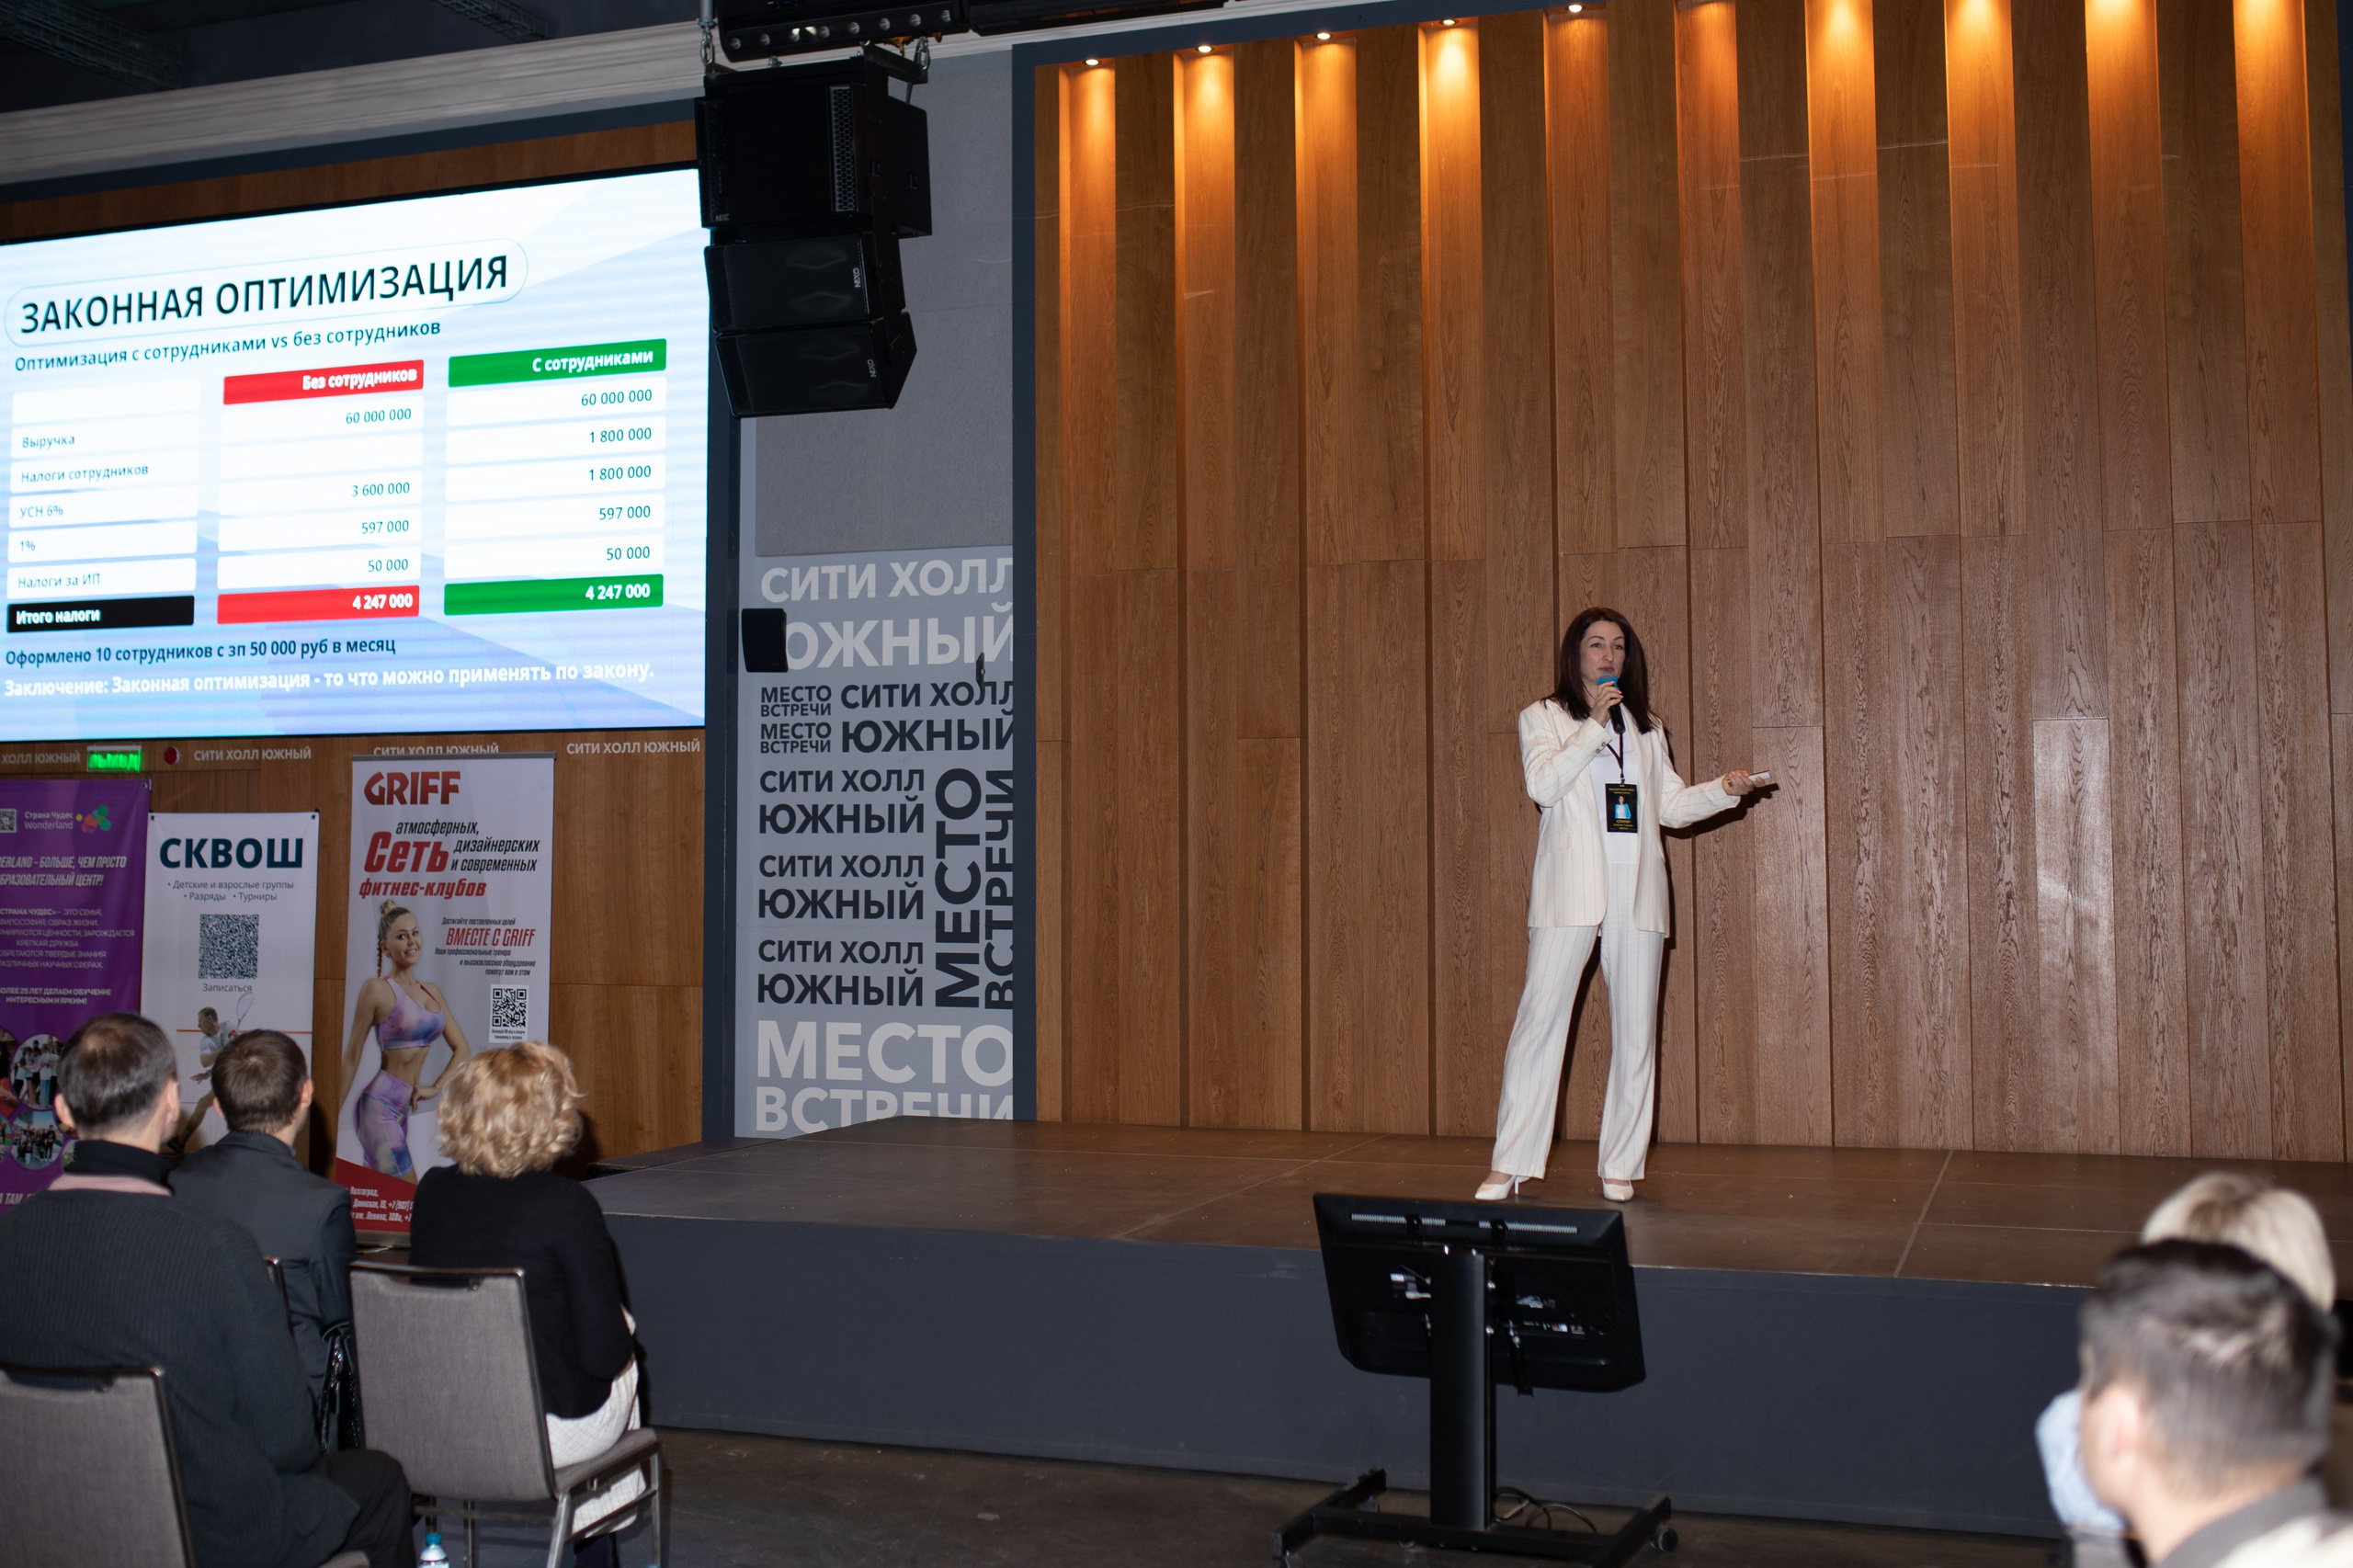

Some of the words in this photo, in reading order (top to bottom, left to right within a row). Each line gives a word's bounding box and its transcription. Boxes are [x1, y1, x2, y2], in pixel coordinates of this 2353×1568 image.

[853, 267, 861, 288] NEXO
[20, 286, 203, 334] ЗАКОННАЯ
[216, 255, 507, 314] ОПТИМИЗАЦИЯ
[15, 350, 127, 371] Оптимизация
[132, 350, 140, 361] с
[144, 337, 266, 362] сотрудниками
[271, 336, 288, 348] vs
[293, 331, 322, 347] без
[326, 322, 441, 347] сотрудников
[532, 358, 541, 372] С
[545, 351, 654, 373] сотрудниками
[867, 359, 877, 378] NEXO
[302, 375, 325, 390] Без
[328, 369, 417, 390] сотрудников
[581, 393, 597, 405] 60
[601, 392, 624, 404] 000
[629, 389, 653, 402] 000
[346, 413, 359, 424] 60
[364, 410, 385, 423] 000
[390, 408, 411, 420] 000
[22, 436, 74, 449] Выручка
[589, 431, 595, 443] 1
[600, 429, 624, 442] 800
[629, 427, 652, 440] 000
[21, 471, 64, 483] Налоги
[68, 466, 148, 482] сотрудников
[588, 469, 594, 481] 1
[599, 467, 623, 481] 800
[628, 465, 652, 478] 000
[352, 485, 358, 496] 3
[362, 483, 384, 496] 600
[388, 482, 410, 494] 000
[19, 506, 43, 518] УСН
[47, 505, 63, 516] 6%
[599, 507, 622, 520] 597
[627, 506, 651, 518] 000
[361, 521, 383, 534] 597
[387, 520, 409, 532] 000
[20, 540, 35, 551] 1%
[607, 548, 621, 561] 50
[627, 546, 650, 559] 000
[368, 560, 382, 572] 50
[386, 558, 409, 571] 000
[17, 576, 62, 588] Налоги
[65, 575, 78, 586] за
[83, 573, 100, 585] ИП
[761, 563, 876, 603] СИТИ
[888, 557, 1013, 598] ХОЛЛ
[585, 585, 595, 600] 4
[597, 584, 622, 599] 247
[625, 583, 651, 598] 000
[352, 596, 361, 609] 4
[363, 594, 387, 609] 247
[389, 593, 413, 608] 000
[16, 610, 53, 625] Итого
[55, 609, 100, 623] налоги
[6, 650, 91, 668] Оформлено
[96, 647, 111, 662] 10
[115, 646, 212, 665] сотрудников
[217, 645, 224, 657] с
[228, 644, 245, 657] зп
[250, 642, 267, 655] 50
[271, 640, 296, 655] 000
[301, 638, 328, 659] руб
[333, 641, 341, 653] в
[347, 639, 396, 654] месяц
[4, 679, 108, 697] Заключение:
[111, 676, 189, 693] Законная
[194, 673, 310, 692] оптимизация
[324, 673, 344, 687] то
[347, 672, 378, 686] что
[382, 669, 444, 686] можно
[449, 666, 551, 687] применять
[556, 665, 578, 680] по
[583, 663, 654, 683] закону.
[761, 686, 832, 703] МЕСТО
[841, 684, 921, 709] СИТИ
[929, 681, 1013, 706] ХОЛЛ
[760, 703, 831, 717] ВСТРЕЧИ
[760, 722, 831, 740] МЕСТО
[841, 708, 1013, 753] ЮЖНЫЙ
[194, 750, 223, 761] СИТИ
[226, 749, 259, 761] ХОЛЛ
[262, 745, 312, 760] ЮЖНЫЙ
[373, 745, 404, 756] СИТИ
[407, 745, 443, 755] ХОЛЛ
[446, 743, 499, 755] ЮЖНЫЙ
[566, 742, 600, 755] СИТИ
[603, 741, 641, 754] ХОЛЛ
[644, 738, 700, 753] ЮЖНЫЙ
[760, 740, 831, 754] ВСТРЕЧИ
[1, 753, 32, 765] ХОЛЛ
[35, 750, 81, 764] ЮЖНЫЙ
[88, 753, 140, 772] ВЫХОД
[363, 770, 460, 806] GRIFF
[759, 769, 833, 793] СИТИ
[841, 769, 924, 792] ХОЛЛ
[24, 811, 50, 820] Страна
[51, 811, 74, 820] Чудес
[758, 795, 924, 835] ЮЖНЫЙ
[24, 821, 74, 830] Wonderland
[395, 819, 480, 836] атмосферных,
[159, 837, 303, 869] СКВОШ
[364, 831, 449, 873] Сеть
[453, 836, 540, 855] дизайнерских
[0, 856, 32, 868] ERLAND
[40, 857, 75, 869] БОЛЬШЕ,
[78, 857, 96, 868] ЧЕМ
[96, 857, 127, 869] ПРОСТО
[450, 859, 458, 871] и
[460, 858, 538, 873] современных
[759, 855, 832, 878] СИТИ
[840, 855, 924, 878] ХОЛЛ
[75, 874, 104, 887] ЦЕНТР!
[173, 881, 208, 890] Детские
[219, 882, 259, 891] взрослые
[262, 882, 294, 891] группы
[358, 878, 487, 900] фитнес-клубов
[935, 768, 982, 1007] МЕСТО
[189, 892, 226, 901] Разряды
[239, 892, 278, 902] Турниры
[984, 770, 1013, 1009] ВСТРЕЧИ
[758, 881, 924, 920] ЮЖНЫЙ
[446, 927, 491, 946] ВМЕСТЕ
[492, 928, 501, 946] С
[502, 928, 536, 947] GRIFF
[758, 939, 832, 963] СИТИ
[839, 940, 923, 964] ХОЛЛ
[202, 983, 252, 993] Записаться
[757, 968, 923, 1007] ЮЖНЫЙ
[756, 1019, 1013, 1086] МЕСТО
